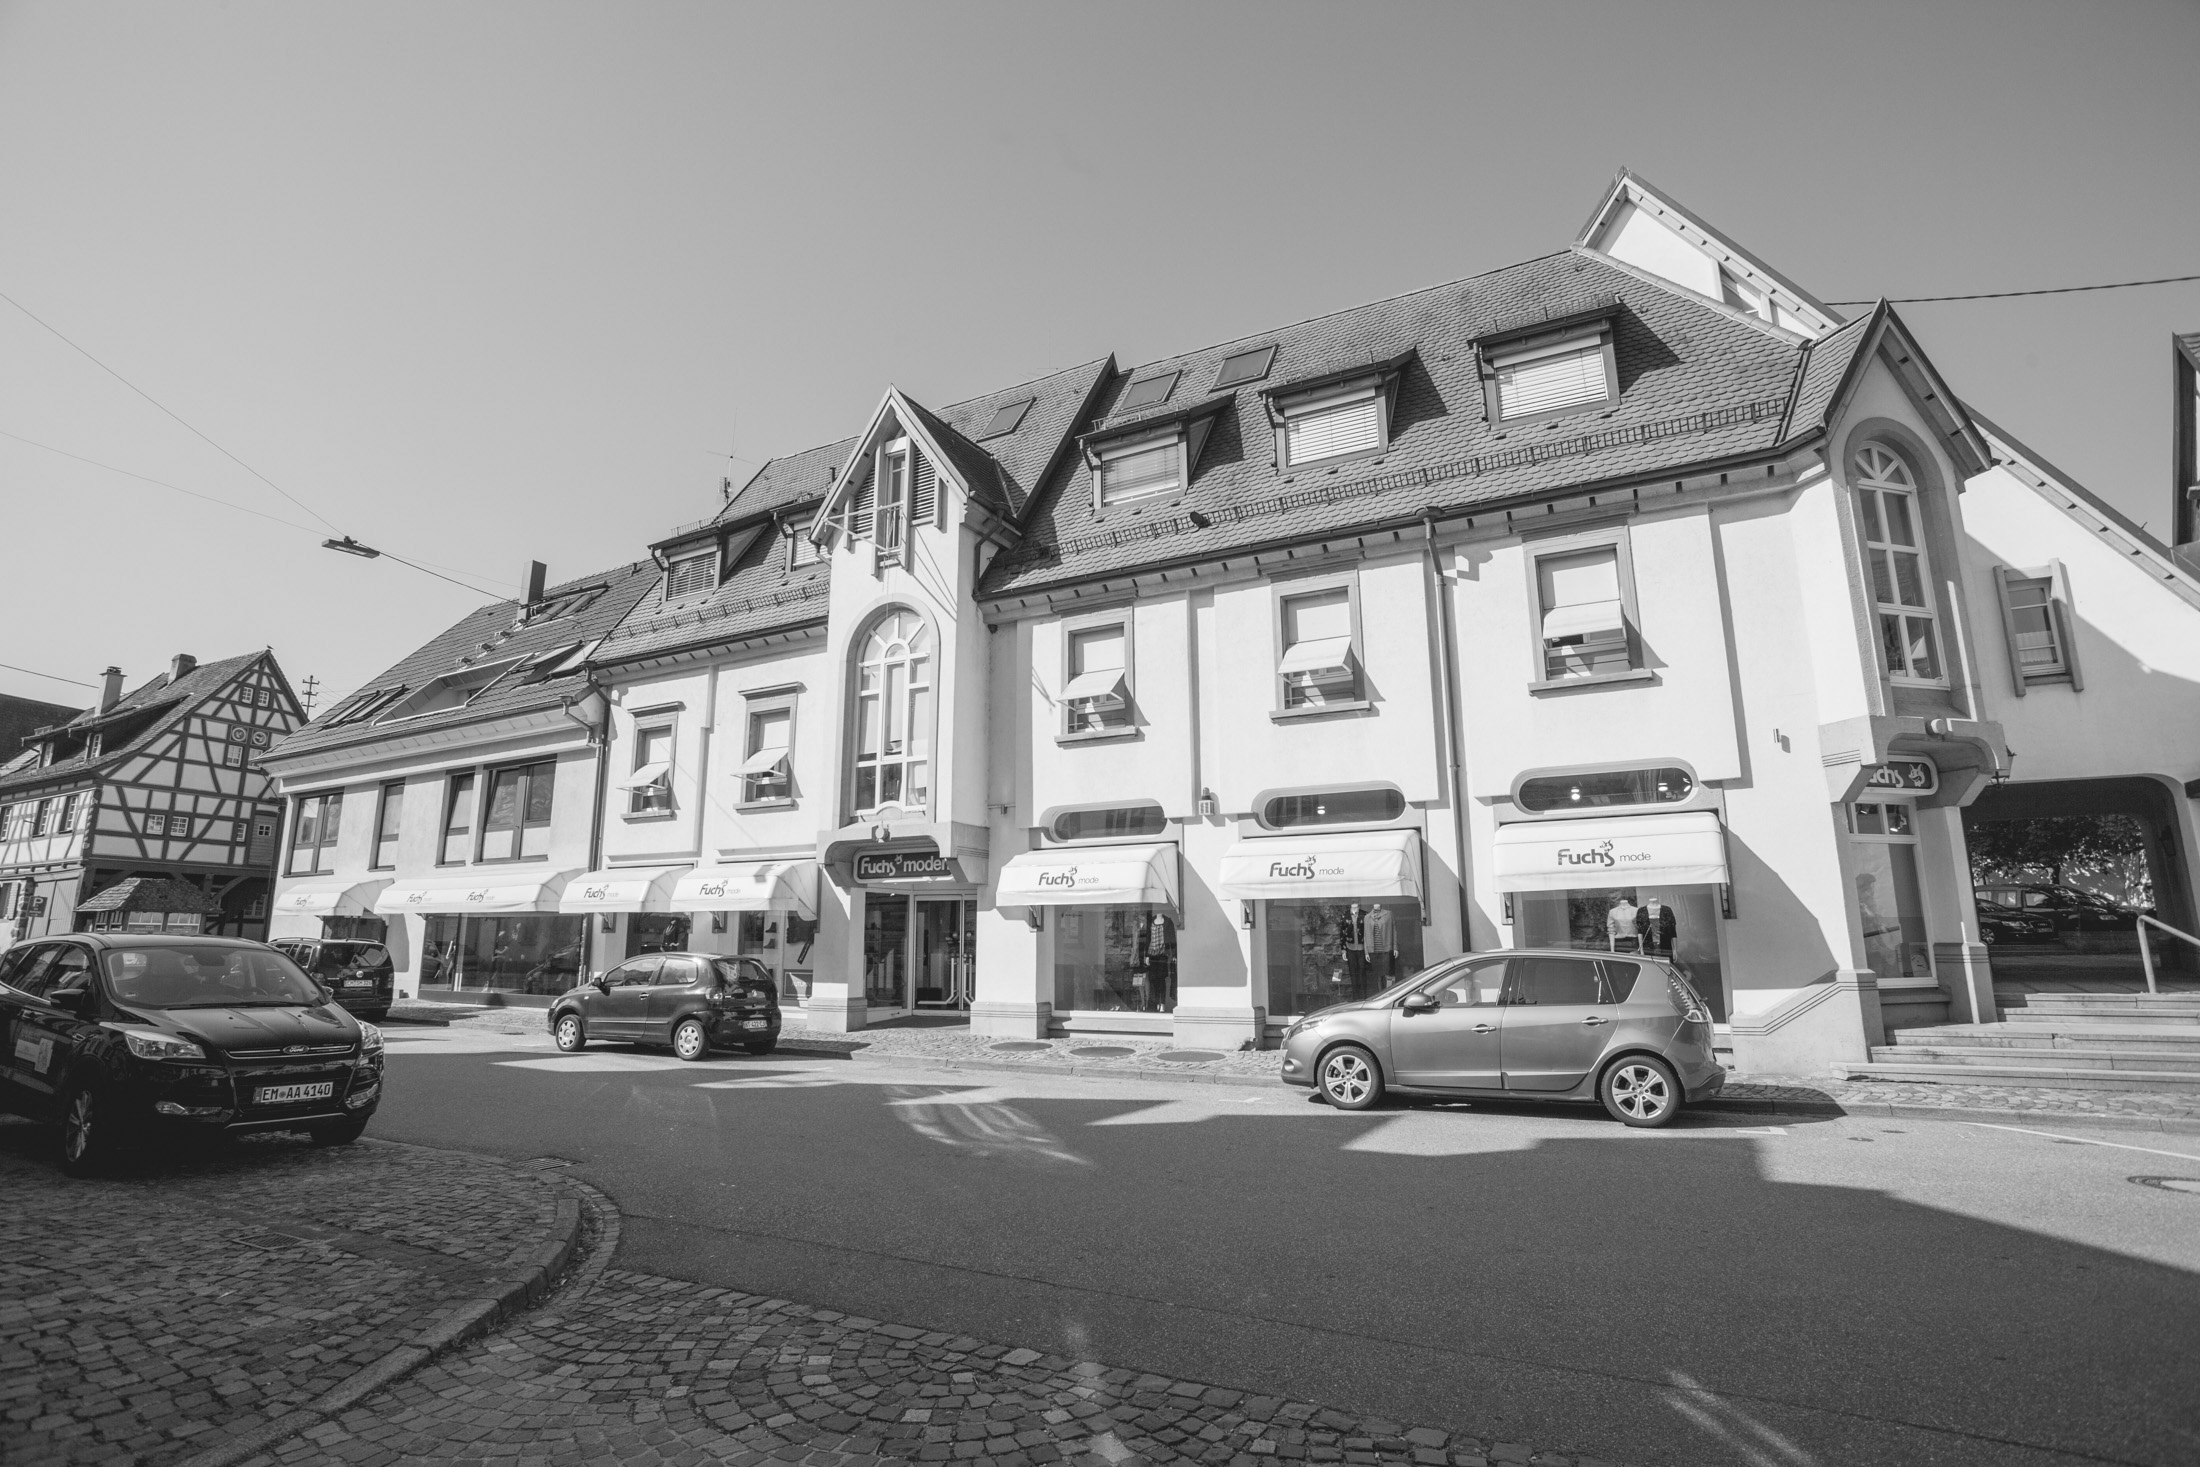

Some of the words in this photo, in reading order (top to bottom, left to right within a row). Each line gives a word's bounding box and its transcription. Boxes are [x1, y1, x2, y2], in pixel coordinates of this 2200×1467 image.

[1869, 765, 1904, 788] uchs
[860, 857, 896, 877] Fuchs
[1557, 848, 1616, 868] Fuchs
[1619, 852, 1652, 862] mode
[1038, 872, 1076, 888] Fuchs
[1078, 875, 1100, 885] mode
[1269, 862, 1316, 880] Fuchs
[1319, 866, 1345, 876] mode
[699, 883, 725, 898] Fuchs
[33, 897, 44, 907] P
[262, 1088, 280, 1101] EM
[286, 1086, 301, 1099] AA
[303, 1083, 331, 1097] 4140
